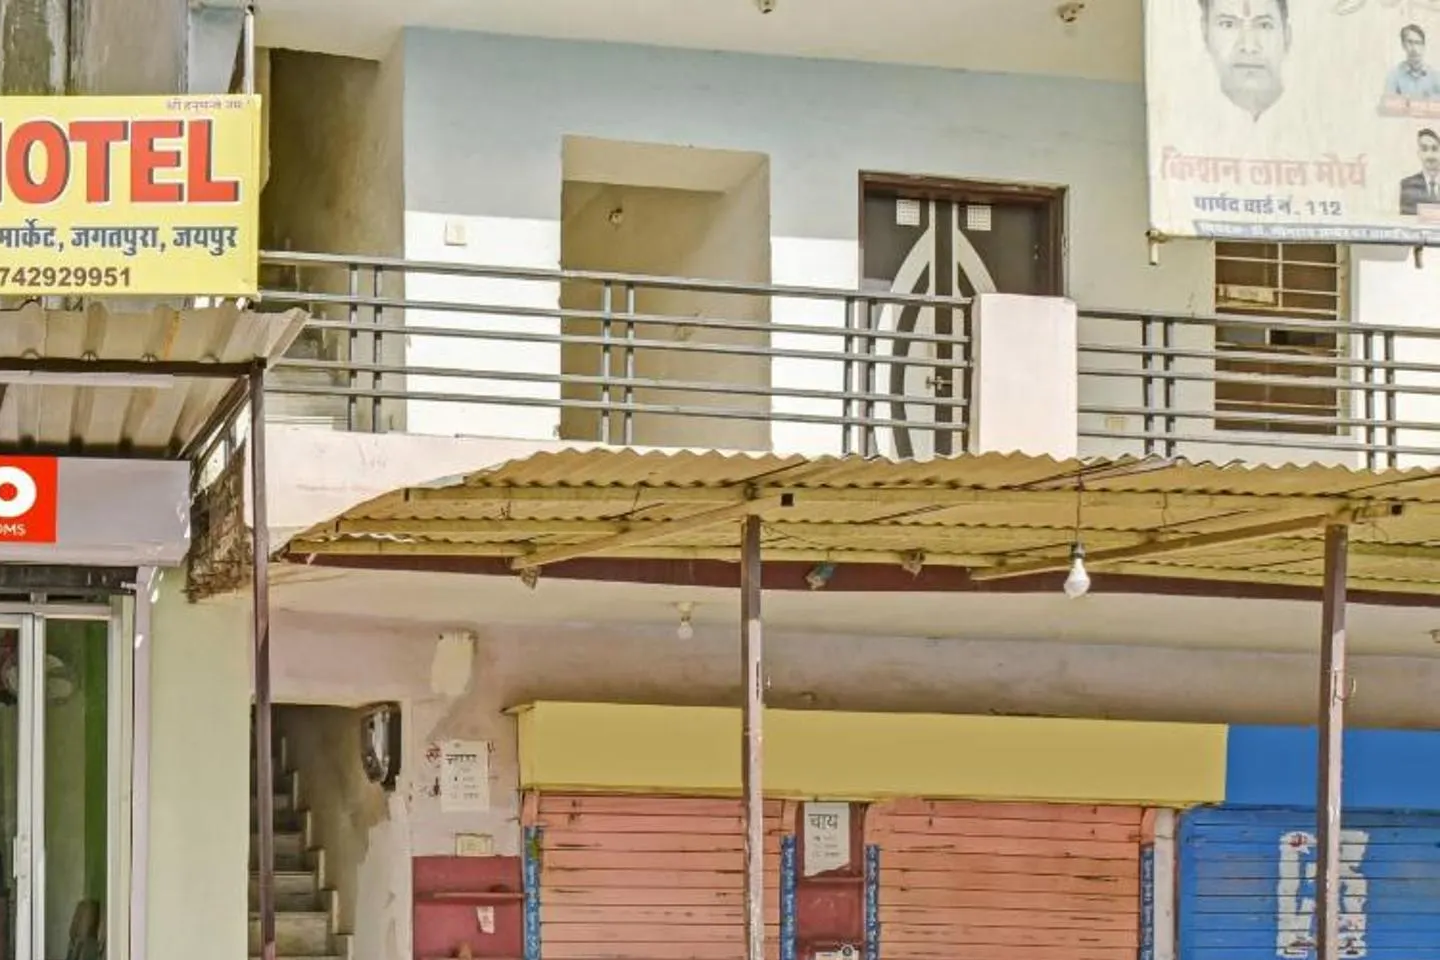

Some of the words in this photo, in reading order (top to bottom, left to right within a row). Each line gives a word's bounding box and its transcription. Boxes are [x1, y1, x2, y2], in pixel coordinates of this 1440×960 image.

[1247, 159, 1308, 187] लाल
[1306, 200, 1343, 216] 112
[70, 226, 167, 257] जगतपुरा,
[172, 226, 239, 257] जयपुर
